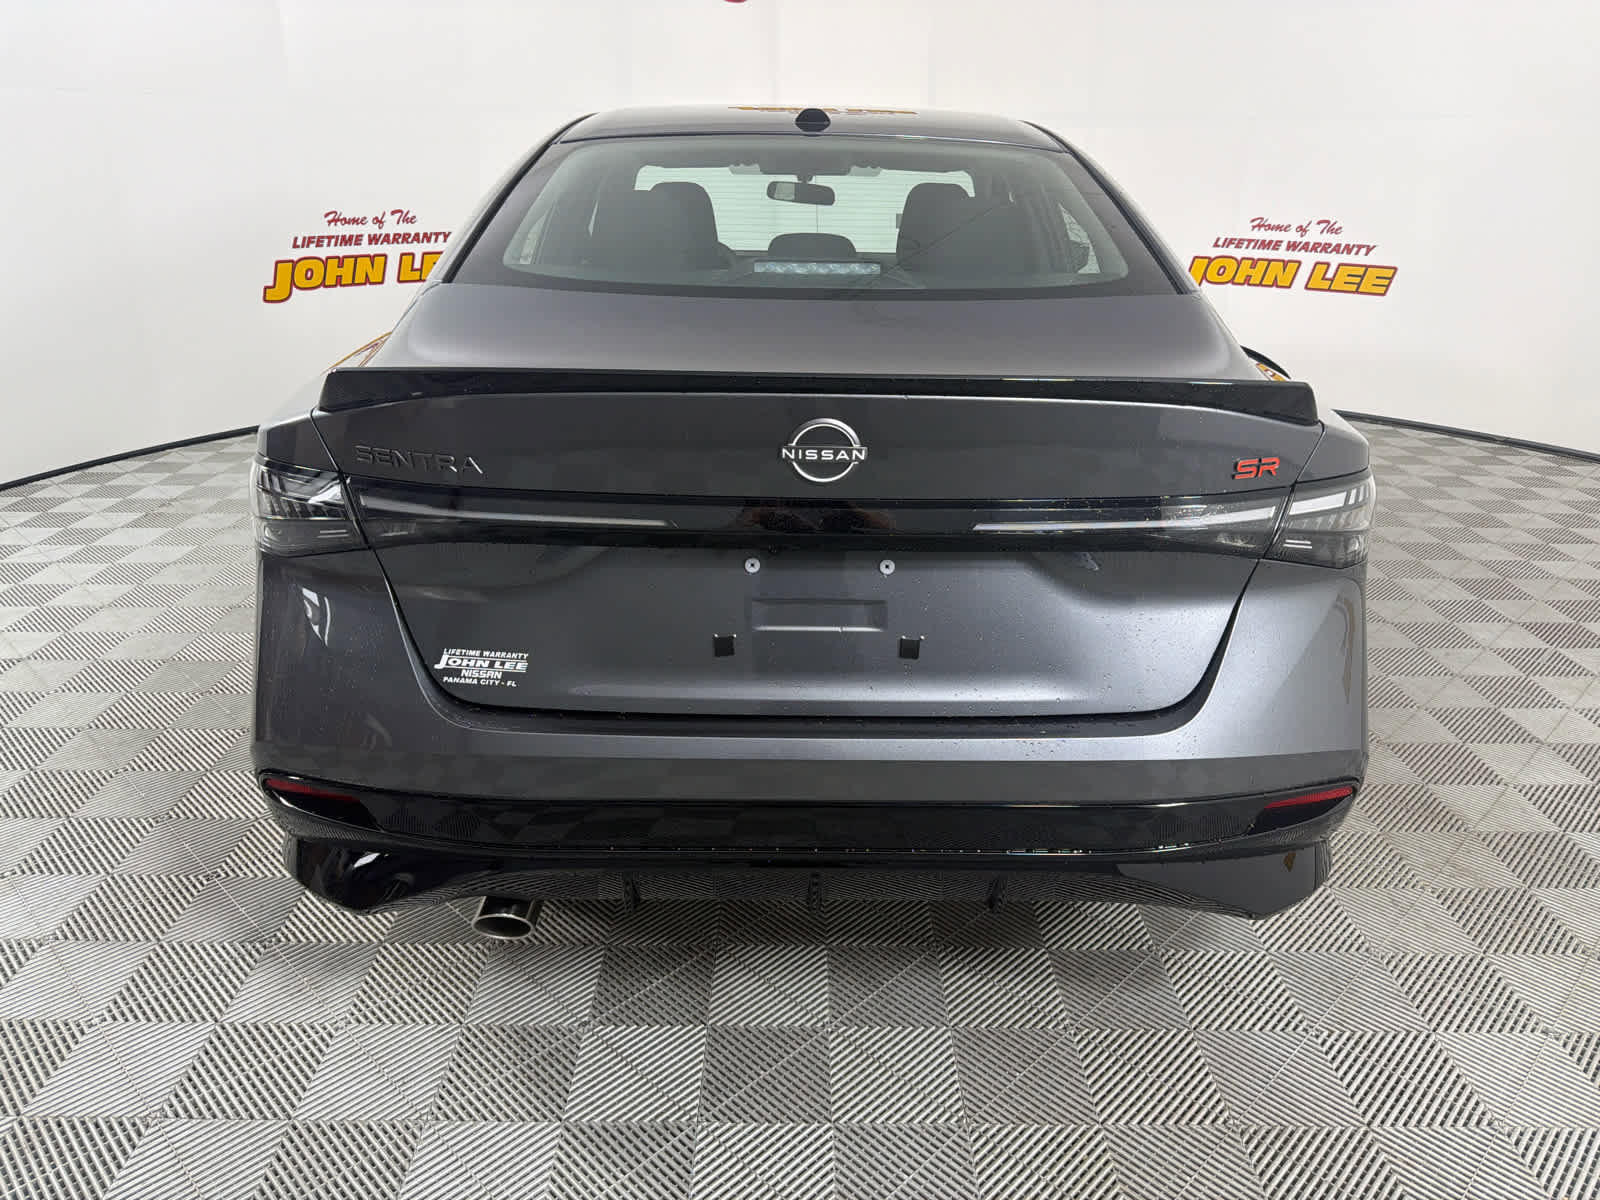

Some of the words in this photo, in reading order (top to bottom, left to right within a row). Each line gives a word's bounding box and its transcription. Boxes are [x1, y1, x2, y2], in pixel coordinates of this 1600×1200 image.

[324, 210, 368, 227] Home
[372, 213, 386, 229] of
[390, 209, 417, 225] The
[1249, 217, 1292, 233] Home
[1295, 219, 1310, 237] of
[1316, 219, 1343, 235] The
[292, 233, 363, 249] LIFETIME
[367, 231, 452, 245] WARRANTY
[1213, 237, 1283, 251] LIFETIME
[1285, 240, 1376, 257] WARRANTY
[263, 253, 388, 303] JOHN
[1304, 261, 1398, 296] LEE
[354, 444, 484, 475] SENTRA
[782, 448, 865, 461] NISSAN
[1233, 456, 1281, 480] SR
[434, 655, 489, 669] JOHN
[494, 660, 528, 670] LEE
[443, 648, 481, 656] LIFETIME
[483, 650, 528, 659] WARRANTY
[443, 677, 477, 685] PANAMA
[461, 669, 502, 679] NISSAN
